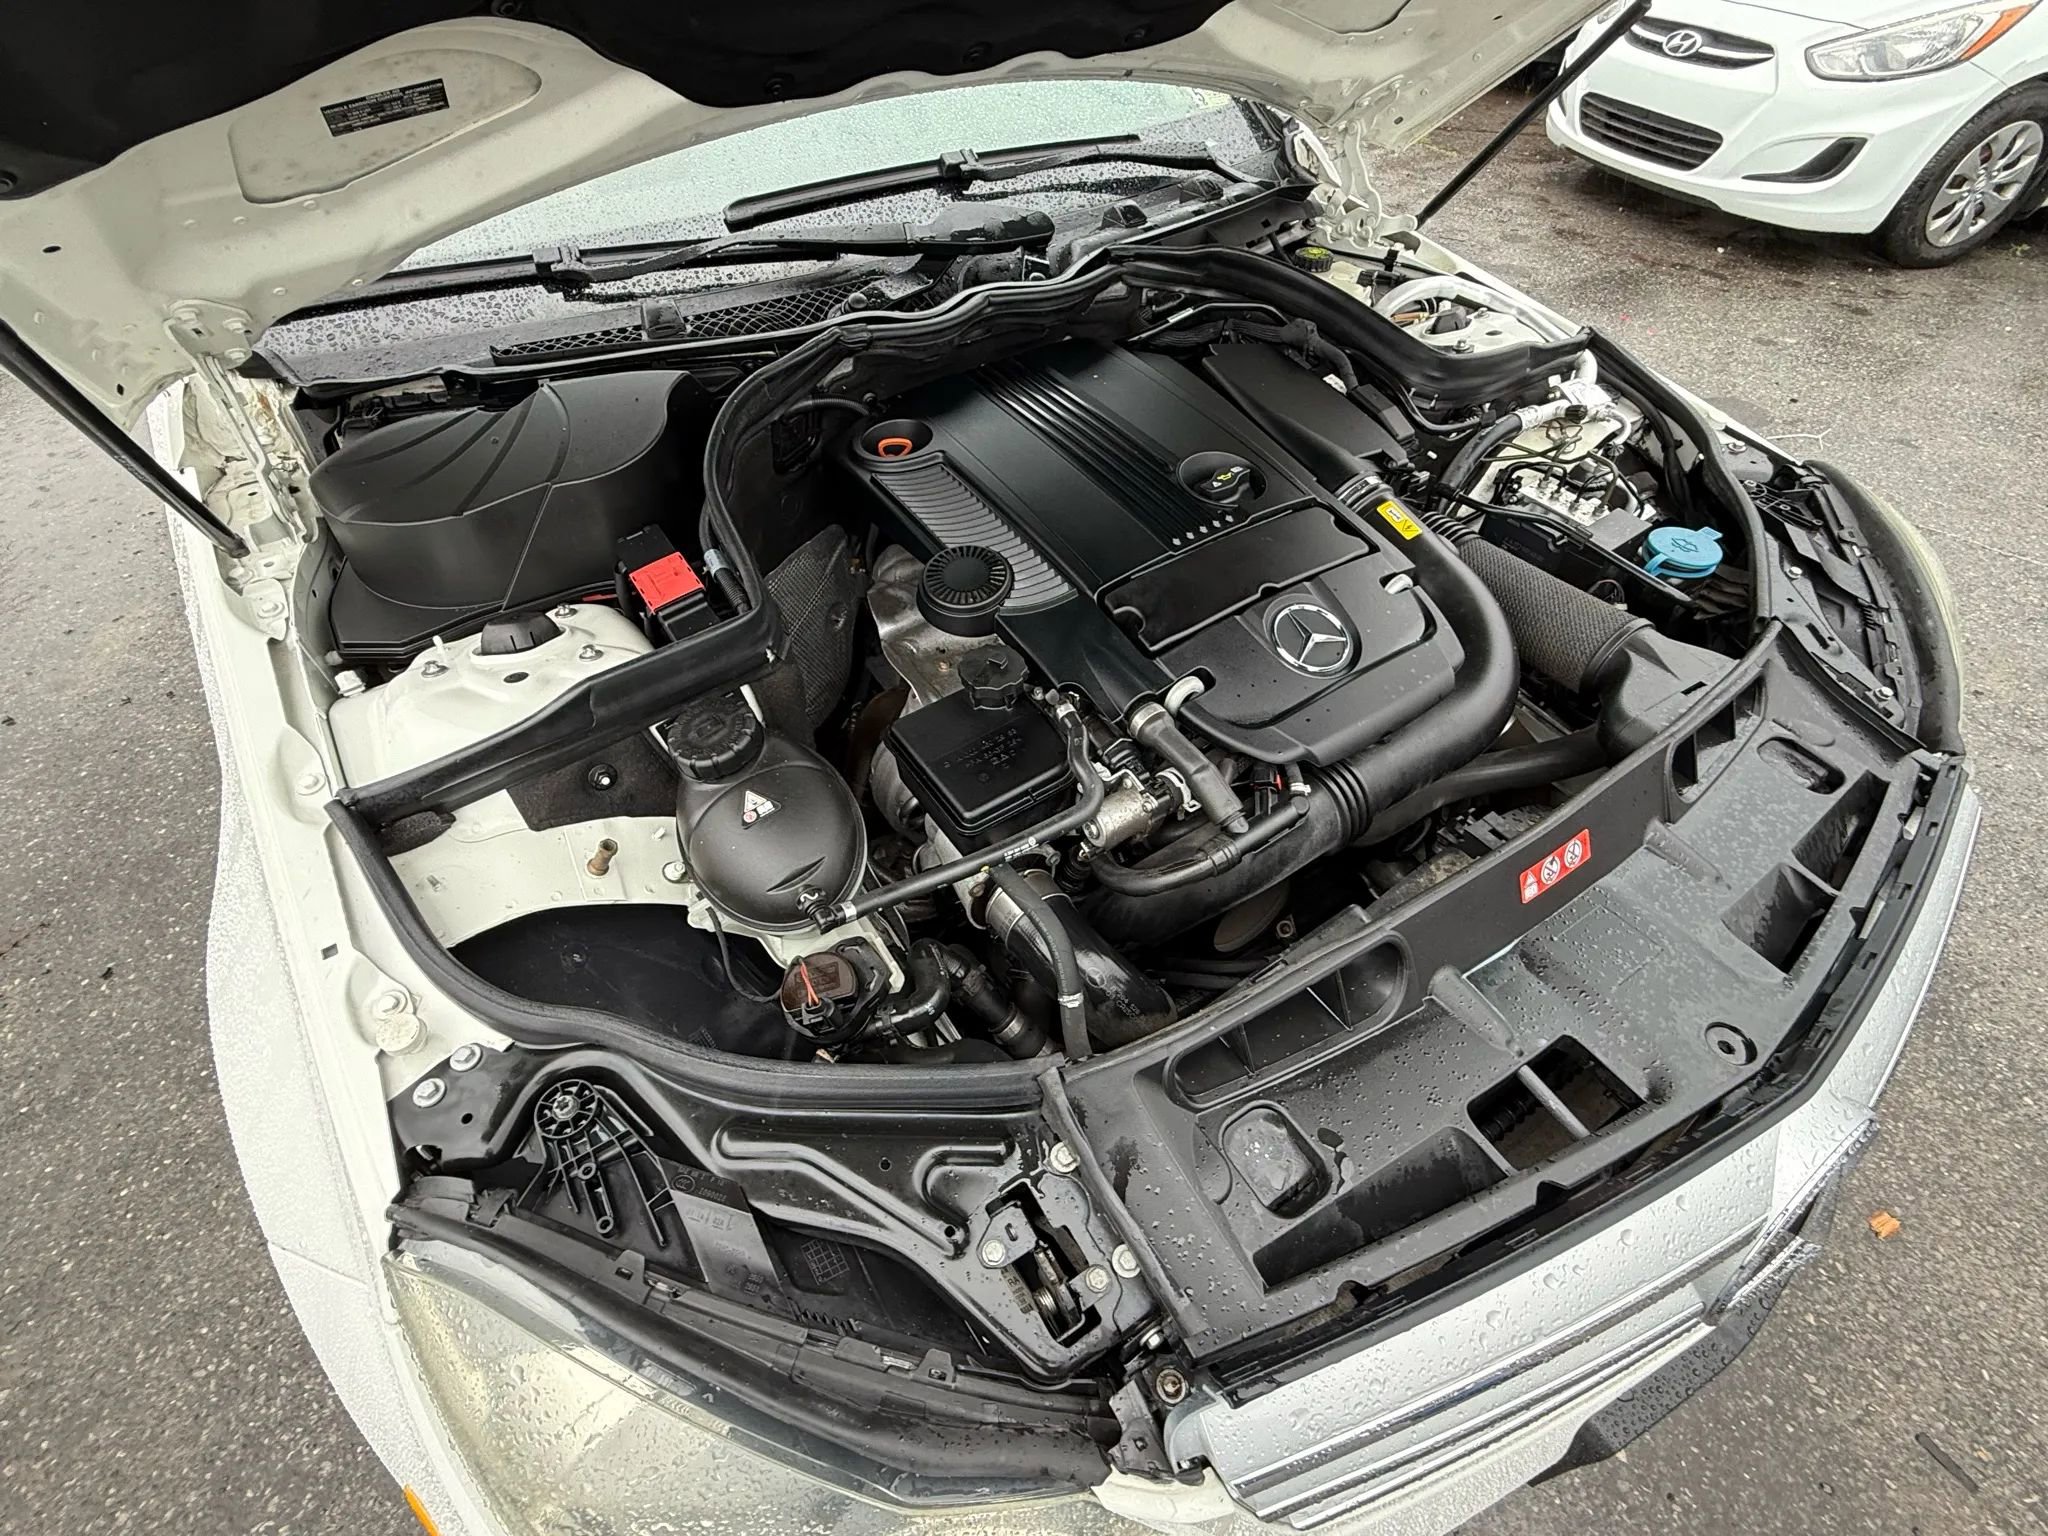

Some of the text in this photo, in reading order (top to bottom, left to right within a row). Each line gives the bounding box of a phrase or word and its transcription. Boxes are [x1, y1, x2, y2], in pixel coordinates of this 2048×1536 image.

[324, 105, 347, 114] VEHICLE
[349, 99, 376, 108] EMISSION
[405, 83, 442, 94] INFORMATION
